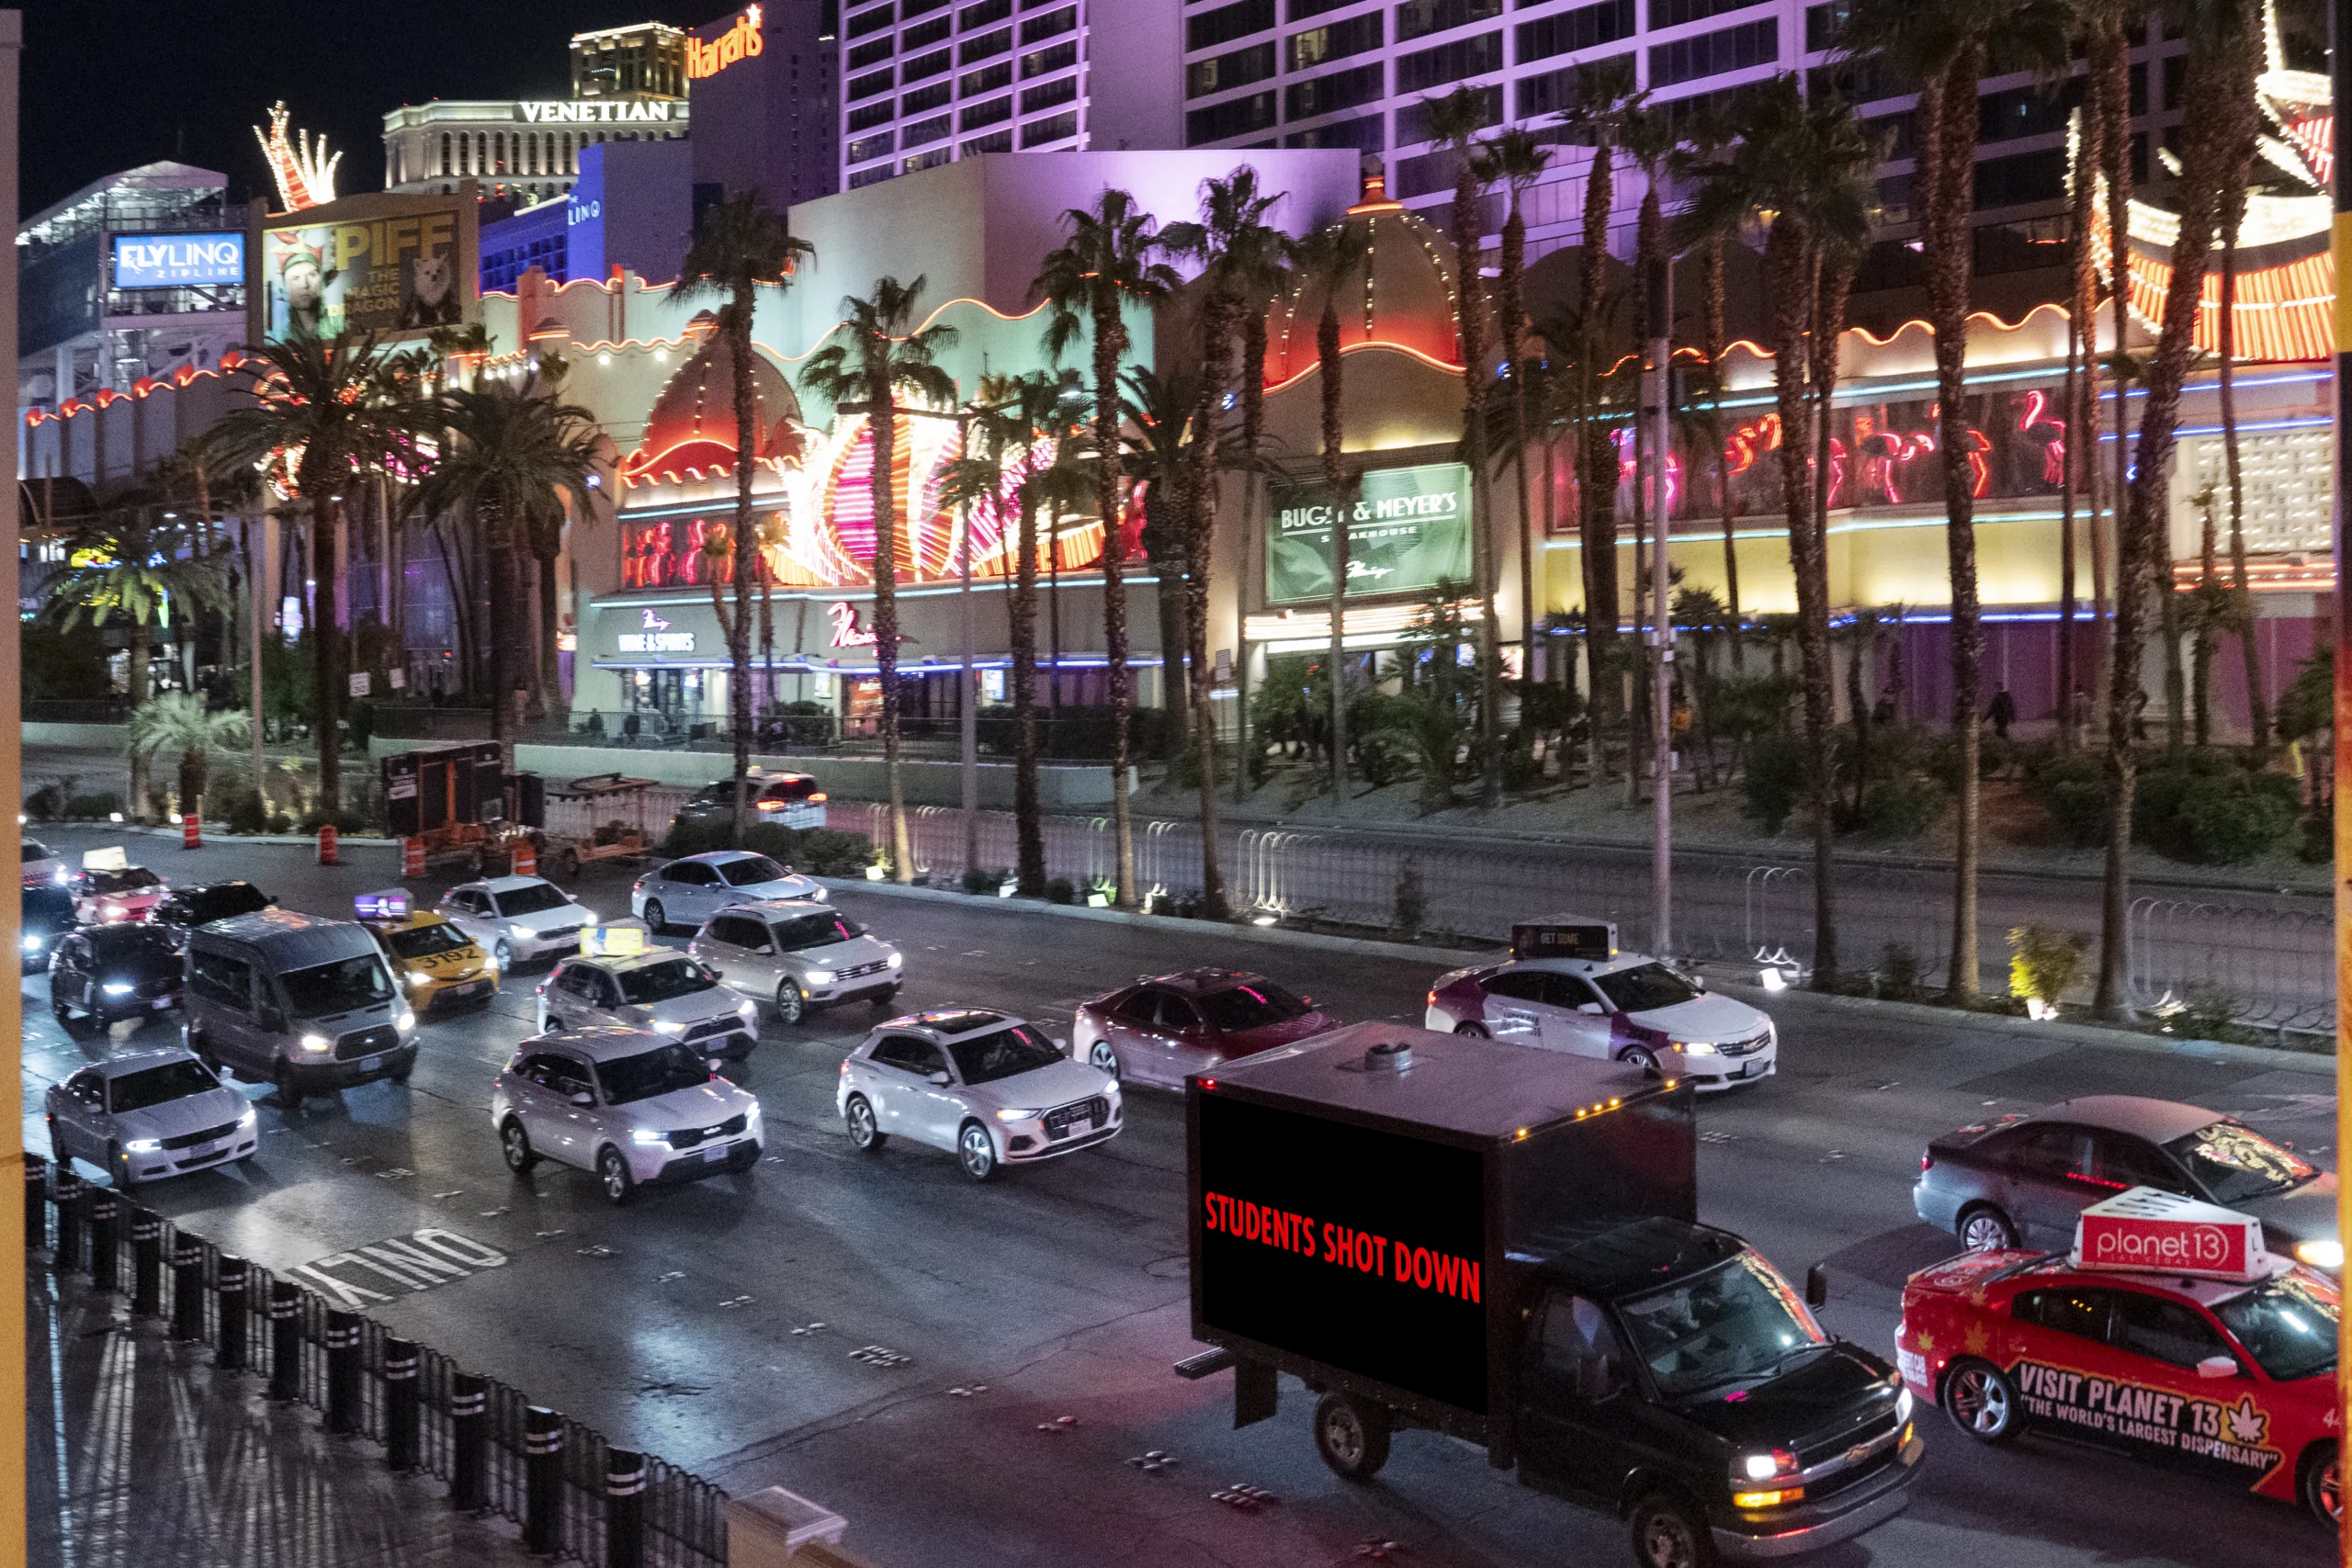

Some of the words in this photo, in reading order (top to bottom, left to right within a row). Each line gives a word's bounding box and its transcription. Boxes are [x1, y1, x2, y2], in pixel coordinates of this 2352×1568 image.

[519, 101, 671, 122] VENETIAN
[568, 200, 601, 226] LINQ
[336, 214, 454, 270] PIFF
[156, 266, 240, 279] ZIPLINE
[369, 267, 400, 282] THE
[345, 283, 400, 297] MAGIC
[327, 296, 400, 317] DRAGON
[1352, 501, 1372, 522] &
[1376, 491, 1457, 519] MEYER'S
[1320, 525, 1418, 544] SAKHOUSE
[1205, 1191, 1316, 1257] STUDENTS
[1323, 1223, 1387, 1277] SHOT
[1395, 1241, 1480, 1304] DOWN
[2097, 1227, 2189, 1258] planet
[2193, 1233, 2221, 1260] 13
[295, 1228, 507, 1308] ONLY
[2020, 1363, 2084, 1404] VISIT
[2088, 1378, 2184, 1428] PLANET
[2190, 1401, 2222, 1438] 13
[2054, 1403, 2115, 1432] WORLD'S
[2119, 1416, 2177, 1448] LARGEST
